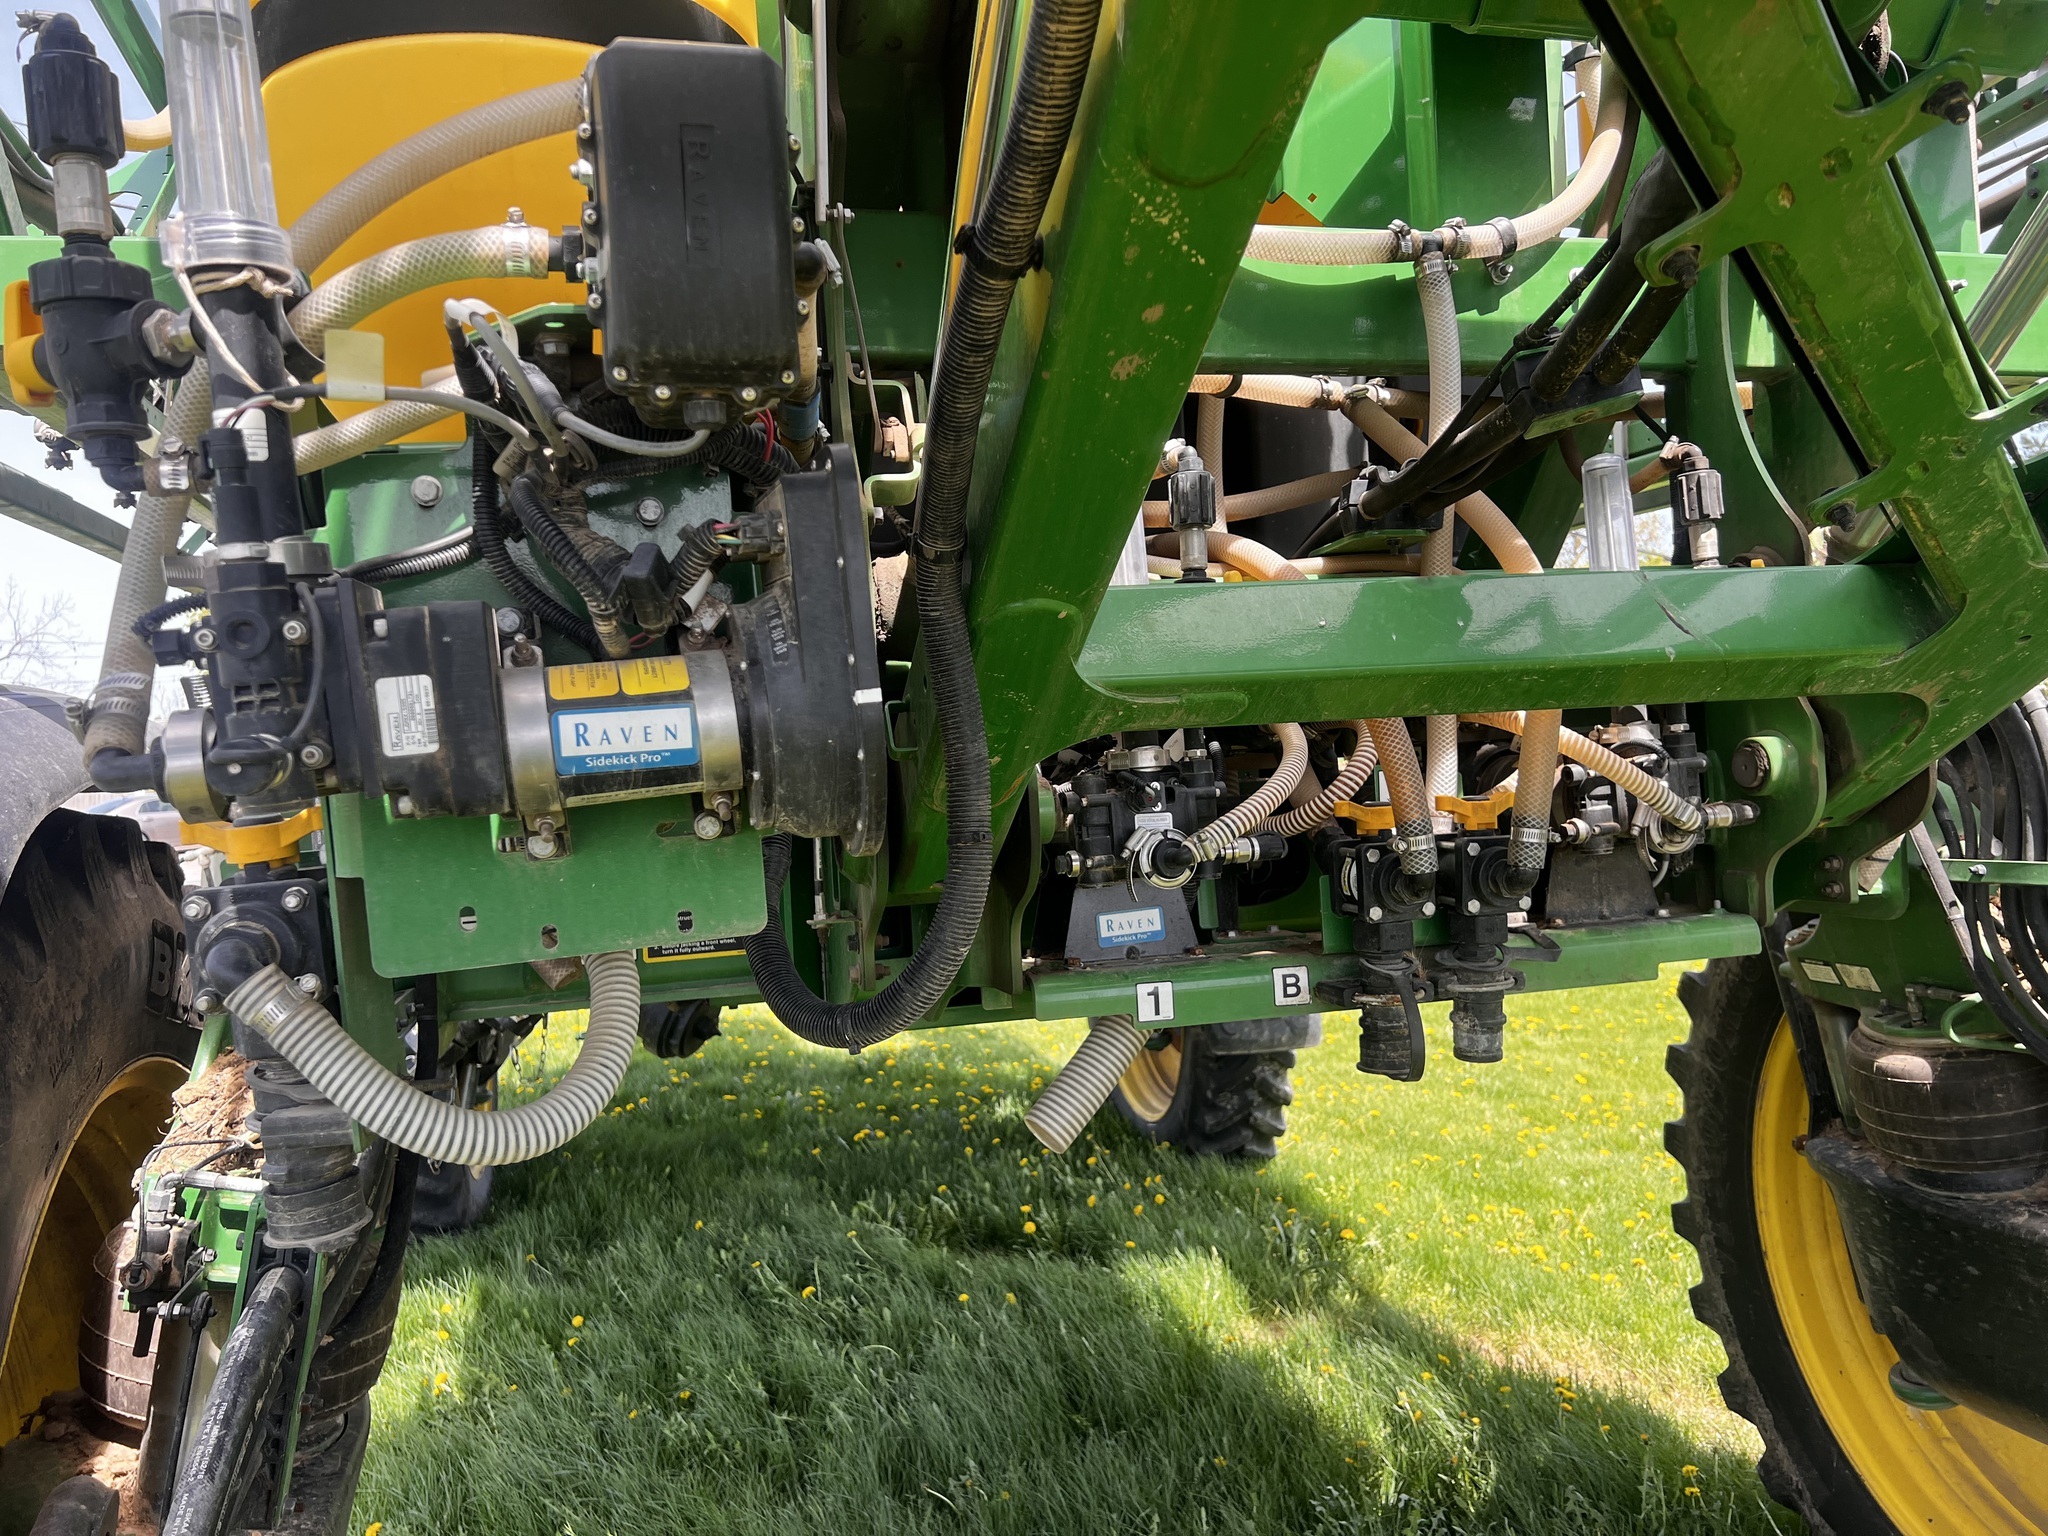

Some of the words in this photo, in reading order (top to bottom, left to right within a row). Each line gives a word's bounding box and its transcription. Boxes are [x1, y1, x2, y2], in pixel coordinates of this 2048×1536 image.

[391, 716, 401, 747] RAVEN
[574, 722, 677, 747] RAVEN
[585, 753, 637, 767] Sidekick
[1106, 917, 1154, 932] RAVEN
[1112, 935, 1136, 943] Sidekick
[1282, 974, 1301, 998] B
[1147, 986, 1160, 1016] 1
[216, 1401, 227, 1420] FRAS
[203, 1416, 213, 1433] TYPE
[178, 1493, 188, 1516] MADE
[173, 1517, 180, 1526] IN
